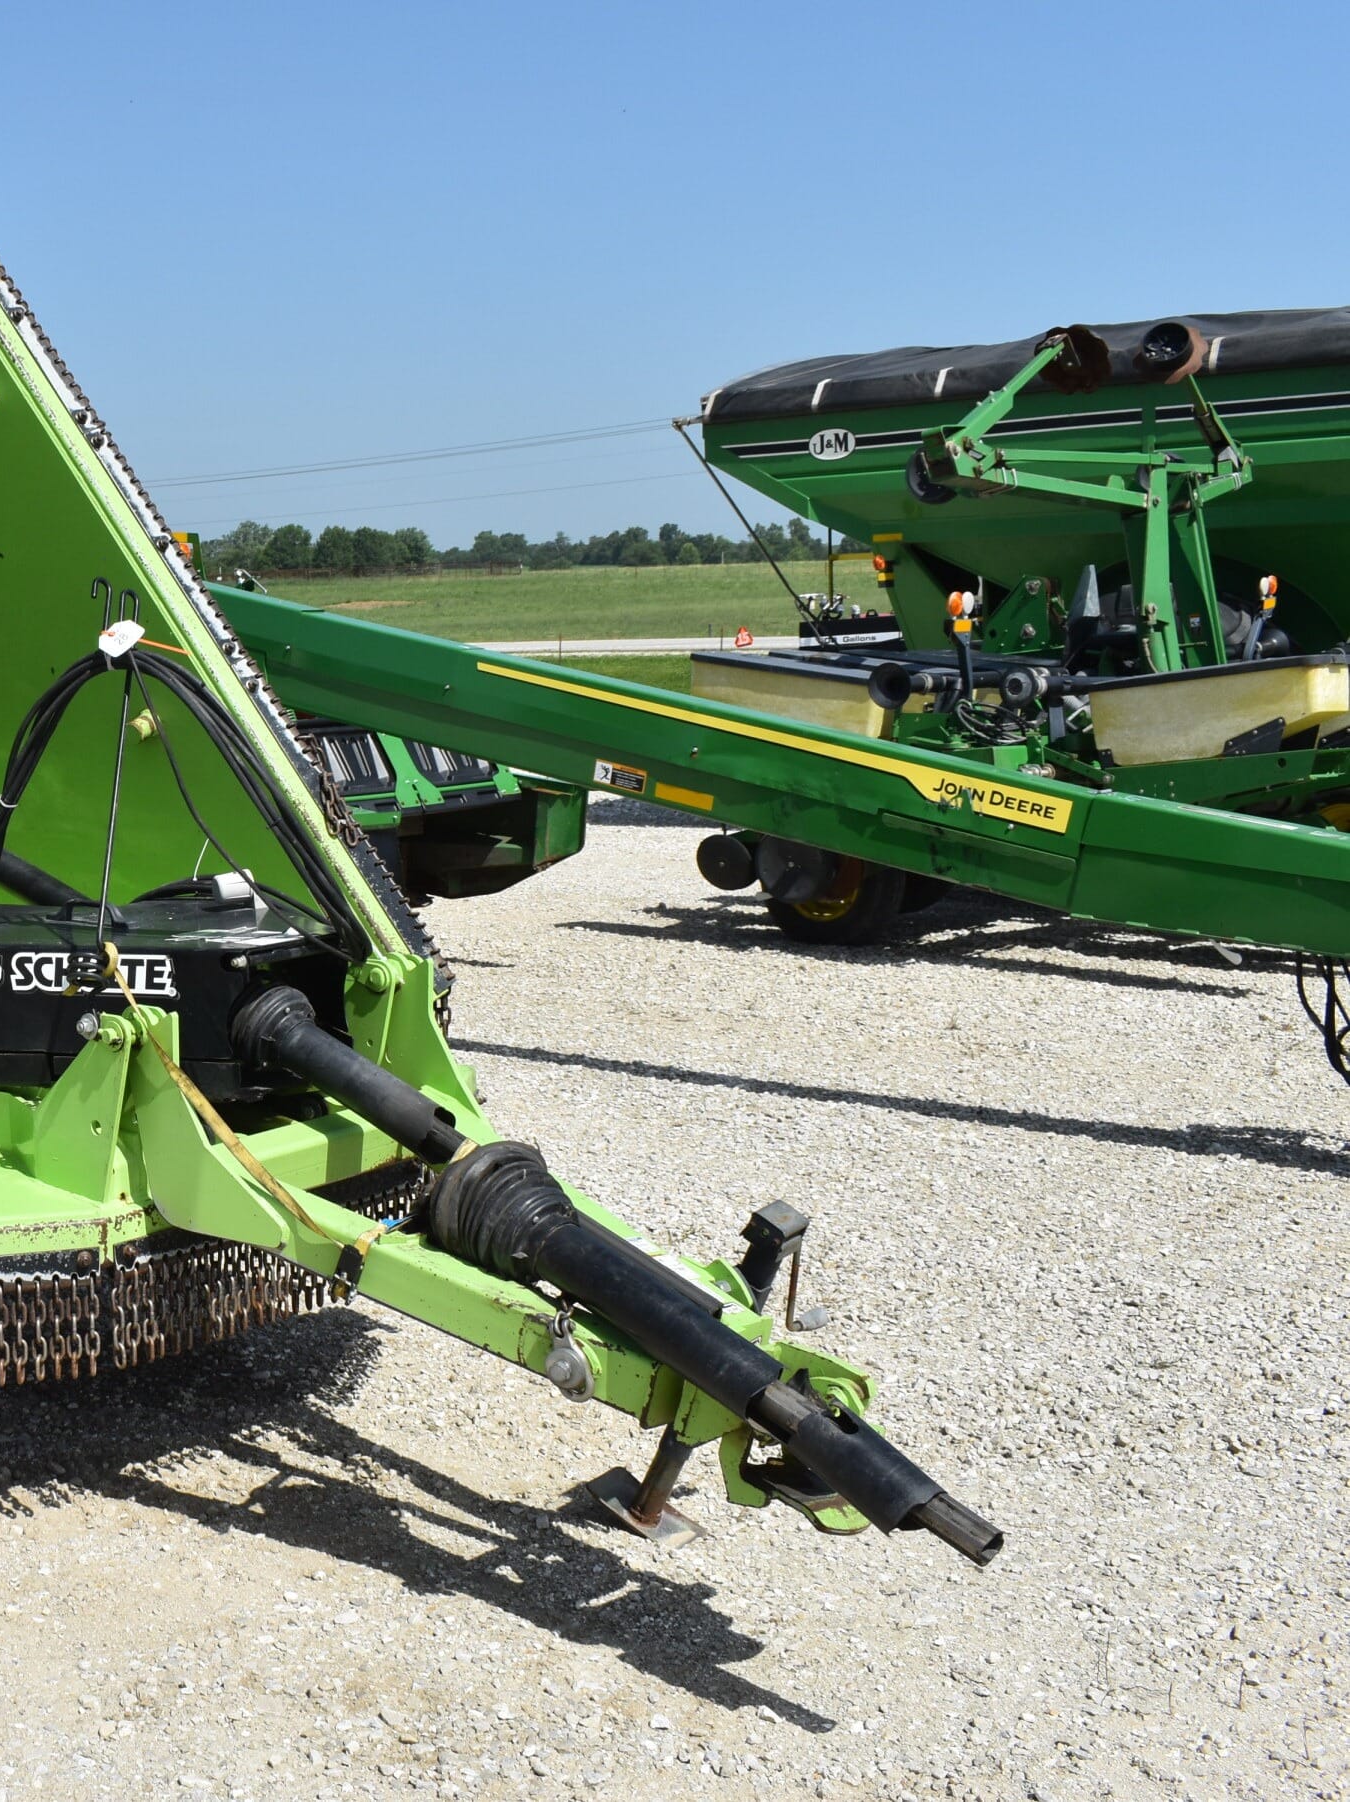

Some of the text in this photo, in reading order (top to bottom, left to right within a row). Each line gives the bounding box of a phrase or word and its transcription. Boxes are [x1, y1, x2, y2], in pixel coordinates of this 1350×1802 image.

[812, 432, 849, 455] J&M
[843, 635, 876, 643] Gallons
[989, 790, 1057, 820] DEERE
[13, 955, 169, 991] SCHTE
